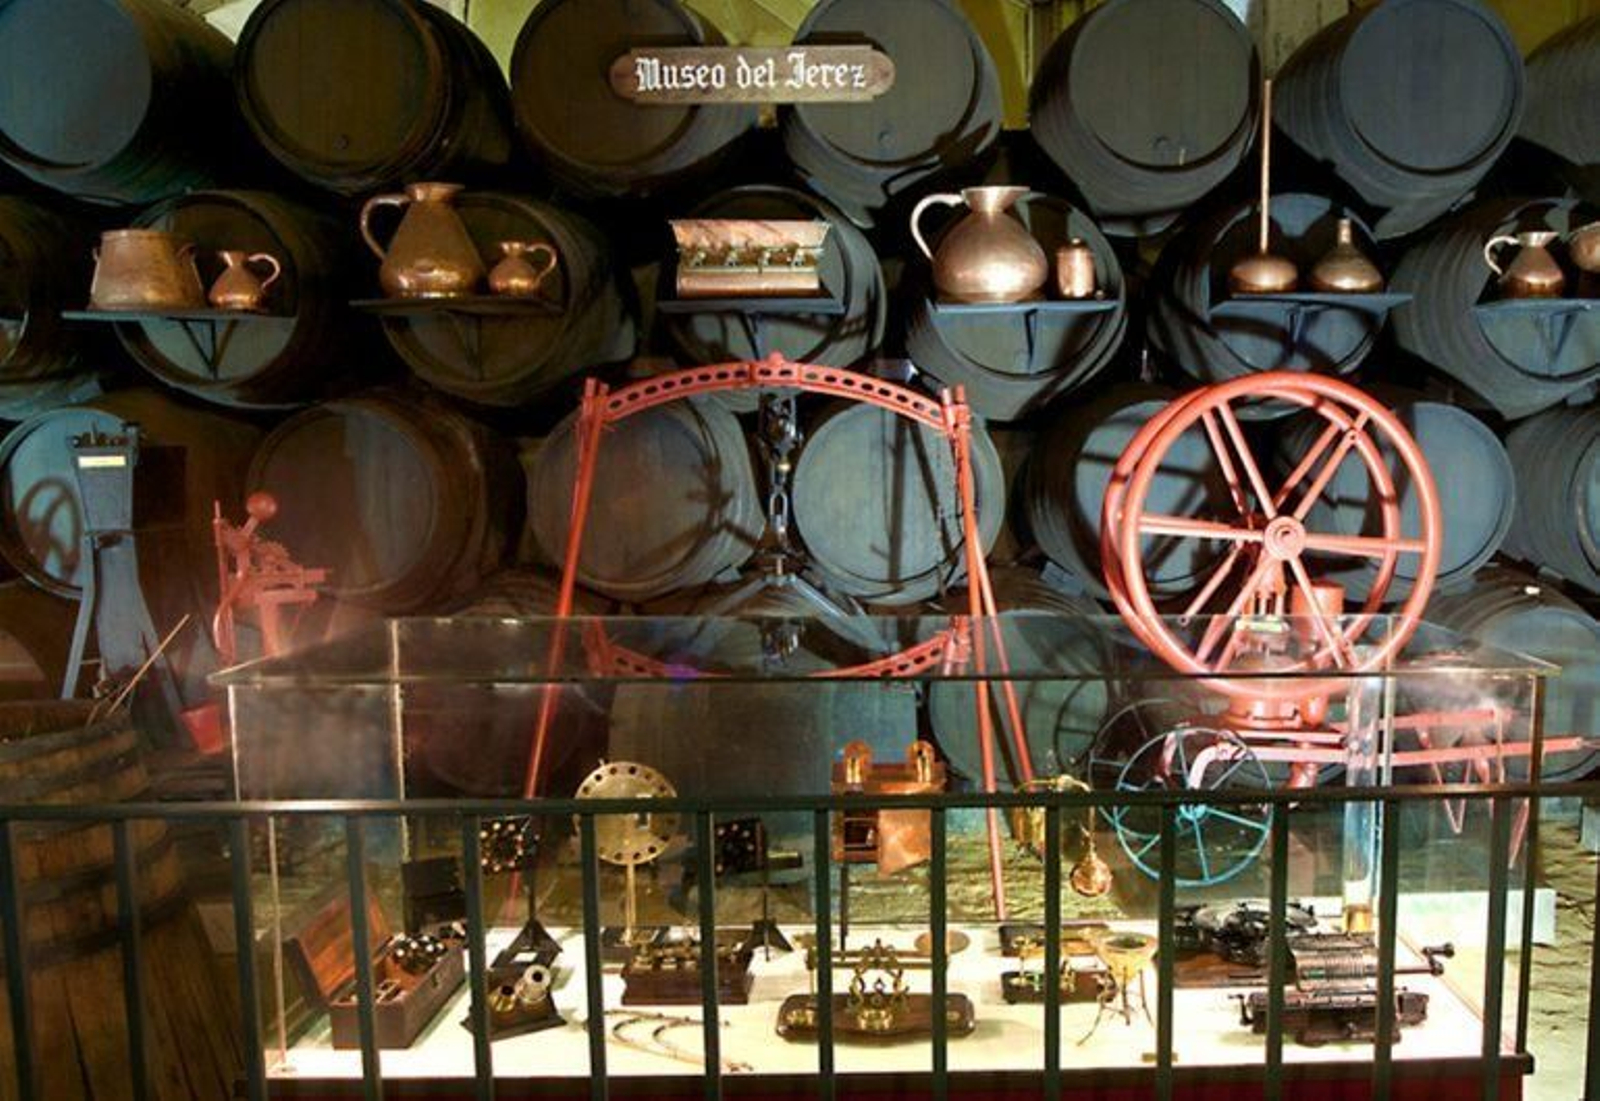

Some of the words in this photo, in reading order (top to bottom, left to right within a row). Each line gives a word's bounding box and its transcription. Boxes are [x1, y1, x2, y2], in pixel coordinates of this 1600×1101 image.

[635, 57, 726, 91] Museo
[736, 55, 776, 89] del
[785, 51, 868, 89] Jerez
